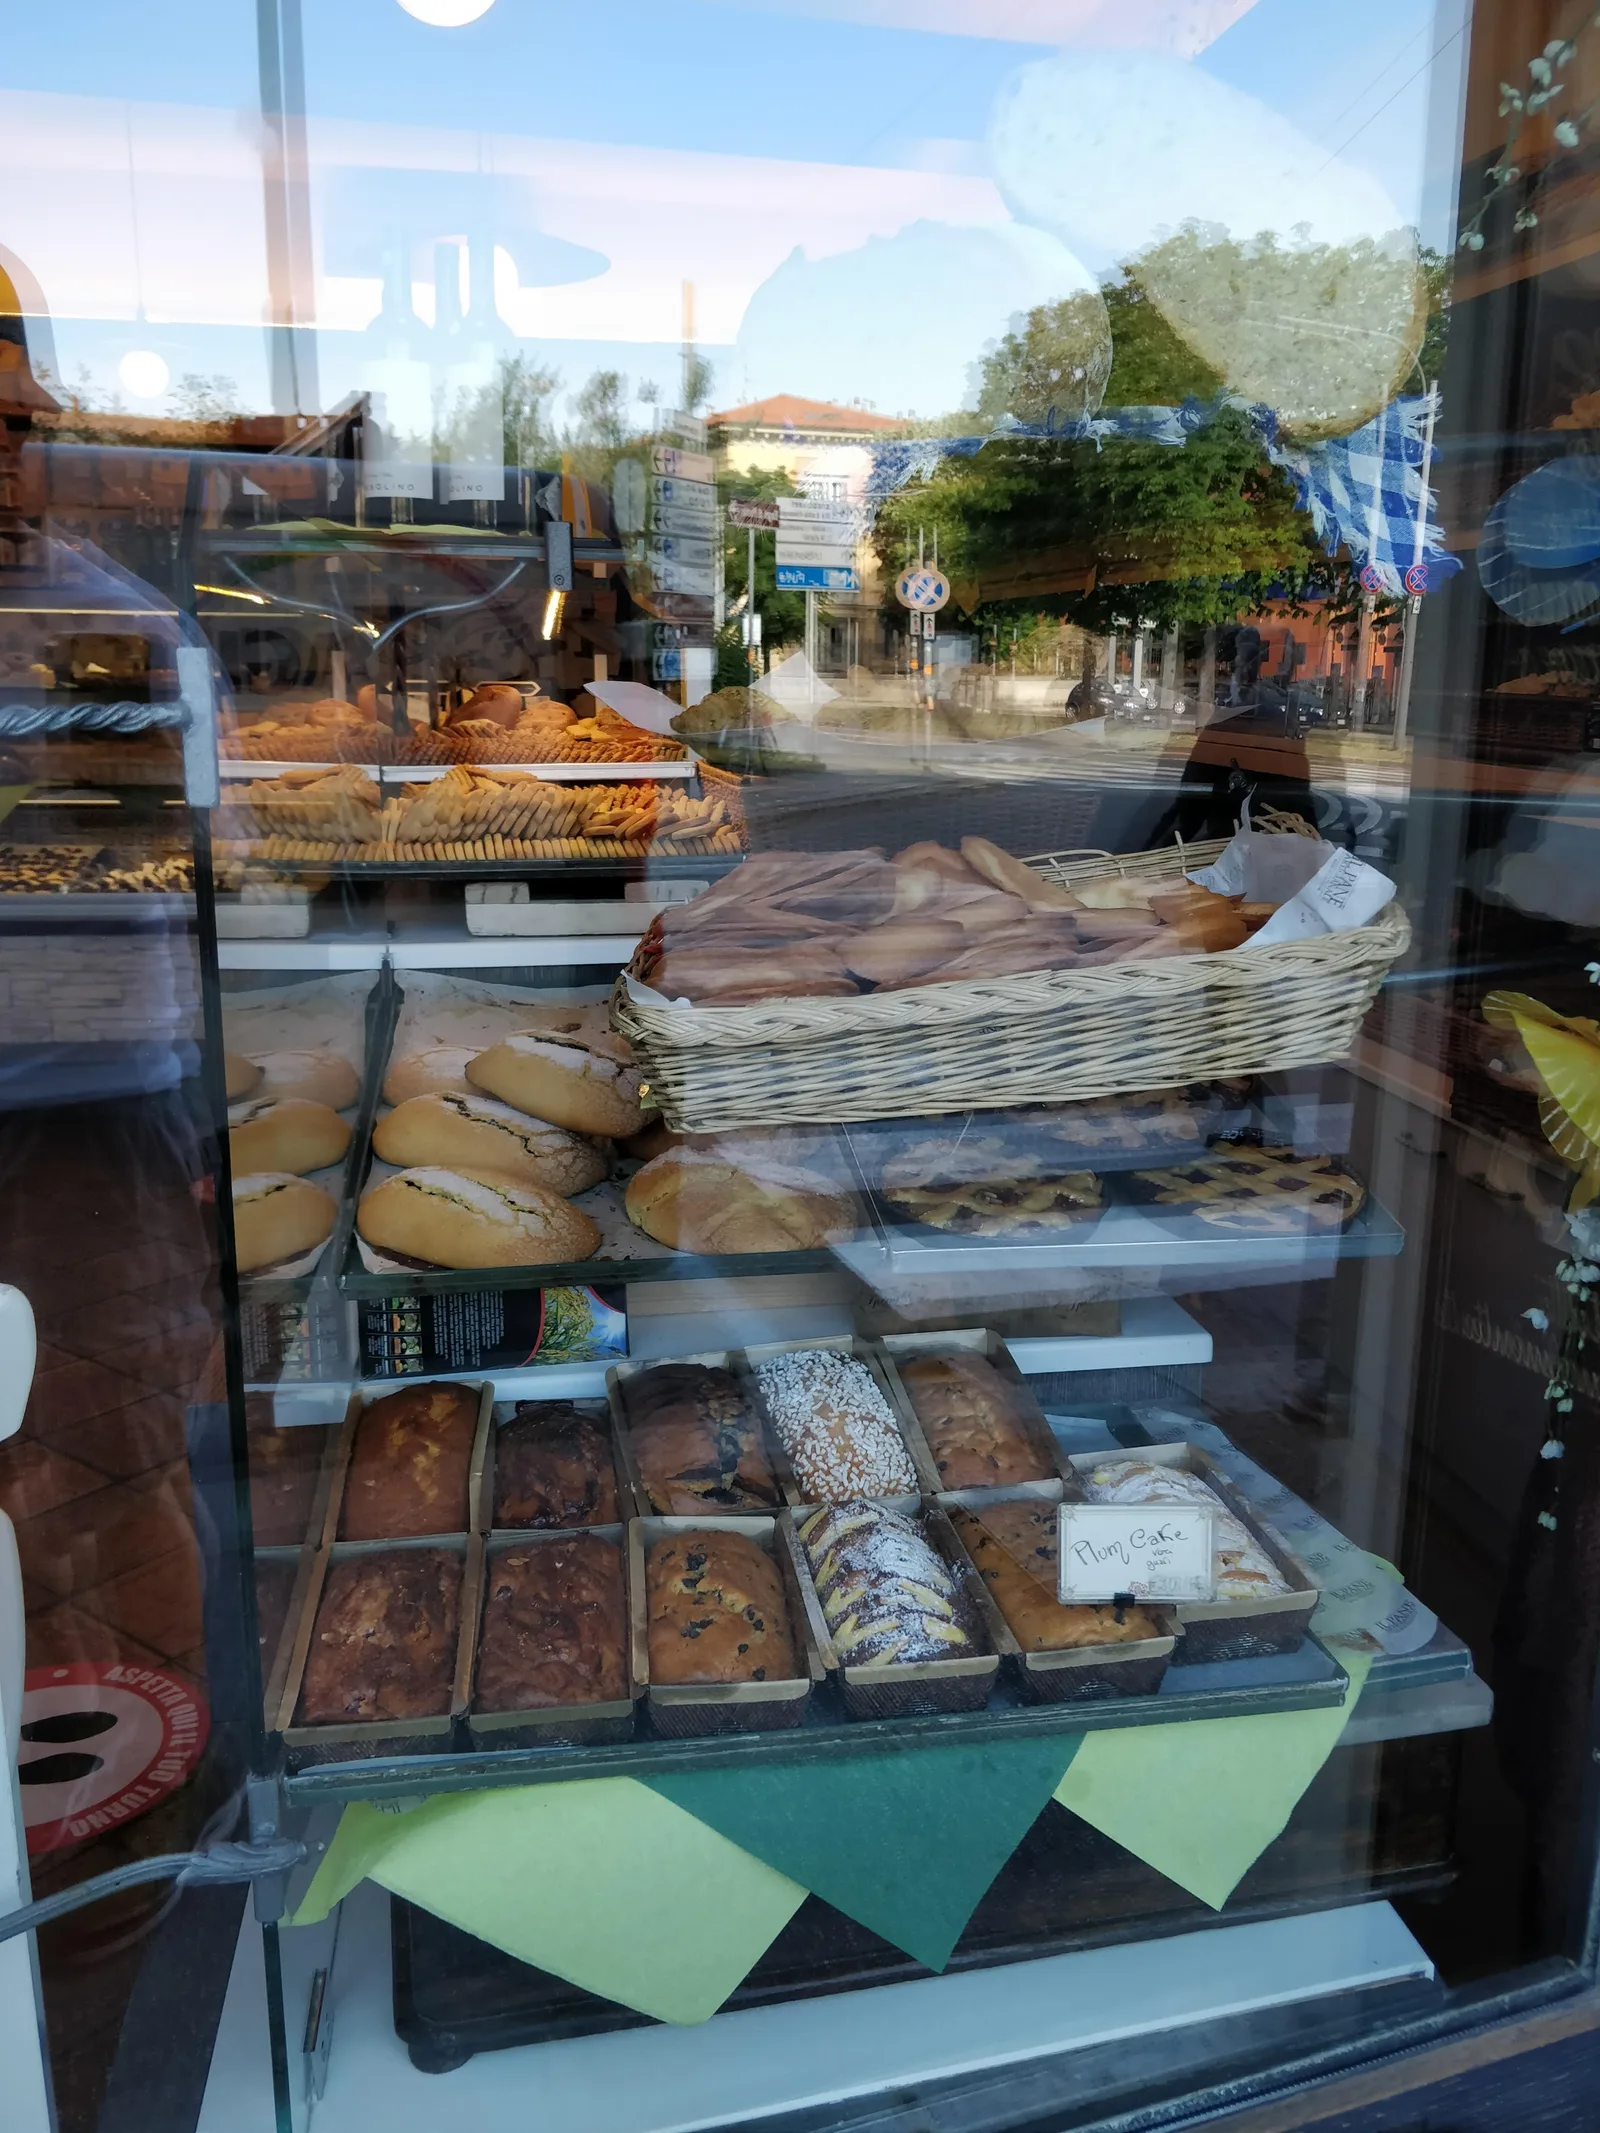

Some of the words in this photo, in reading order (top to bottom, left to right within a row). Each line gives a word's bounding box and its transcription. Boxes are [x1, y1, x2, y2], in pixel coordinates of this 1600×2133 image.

[1069, 1539, 1130, 1566] Plum
[1129, 1522, 1189, 1549] Cake
[102, 1665, 188, 1707] ASPETTA
[167, 1703, 199, 1731] QUI
[147, 1749, 192, 1783] TUO
[68, 1785, 161, 1838] TURNO
